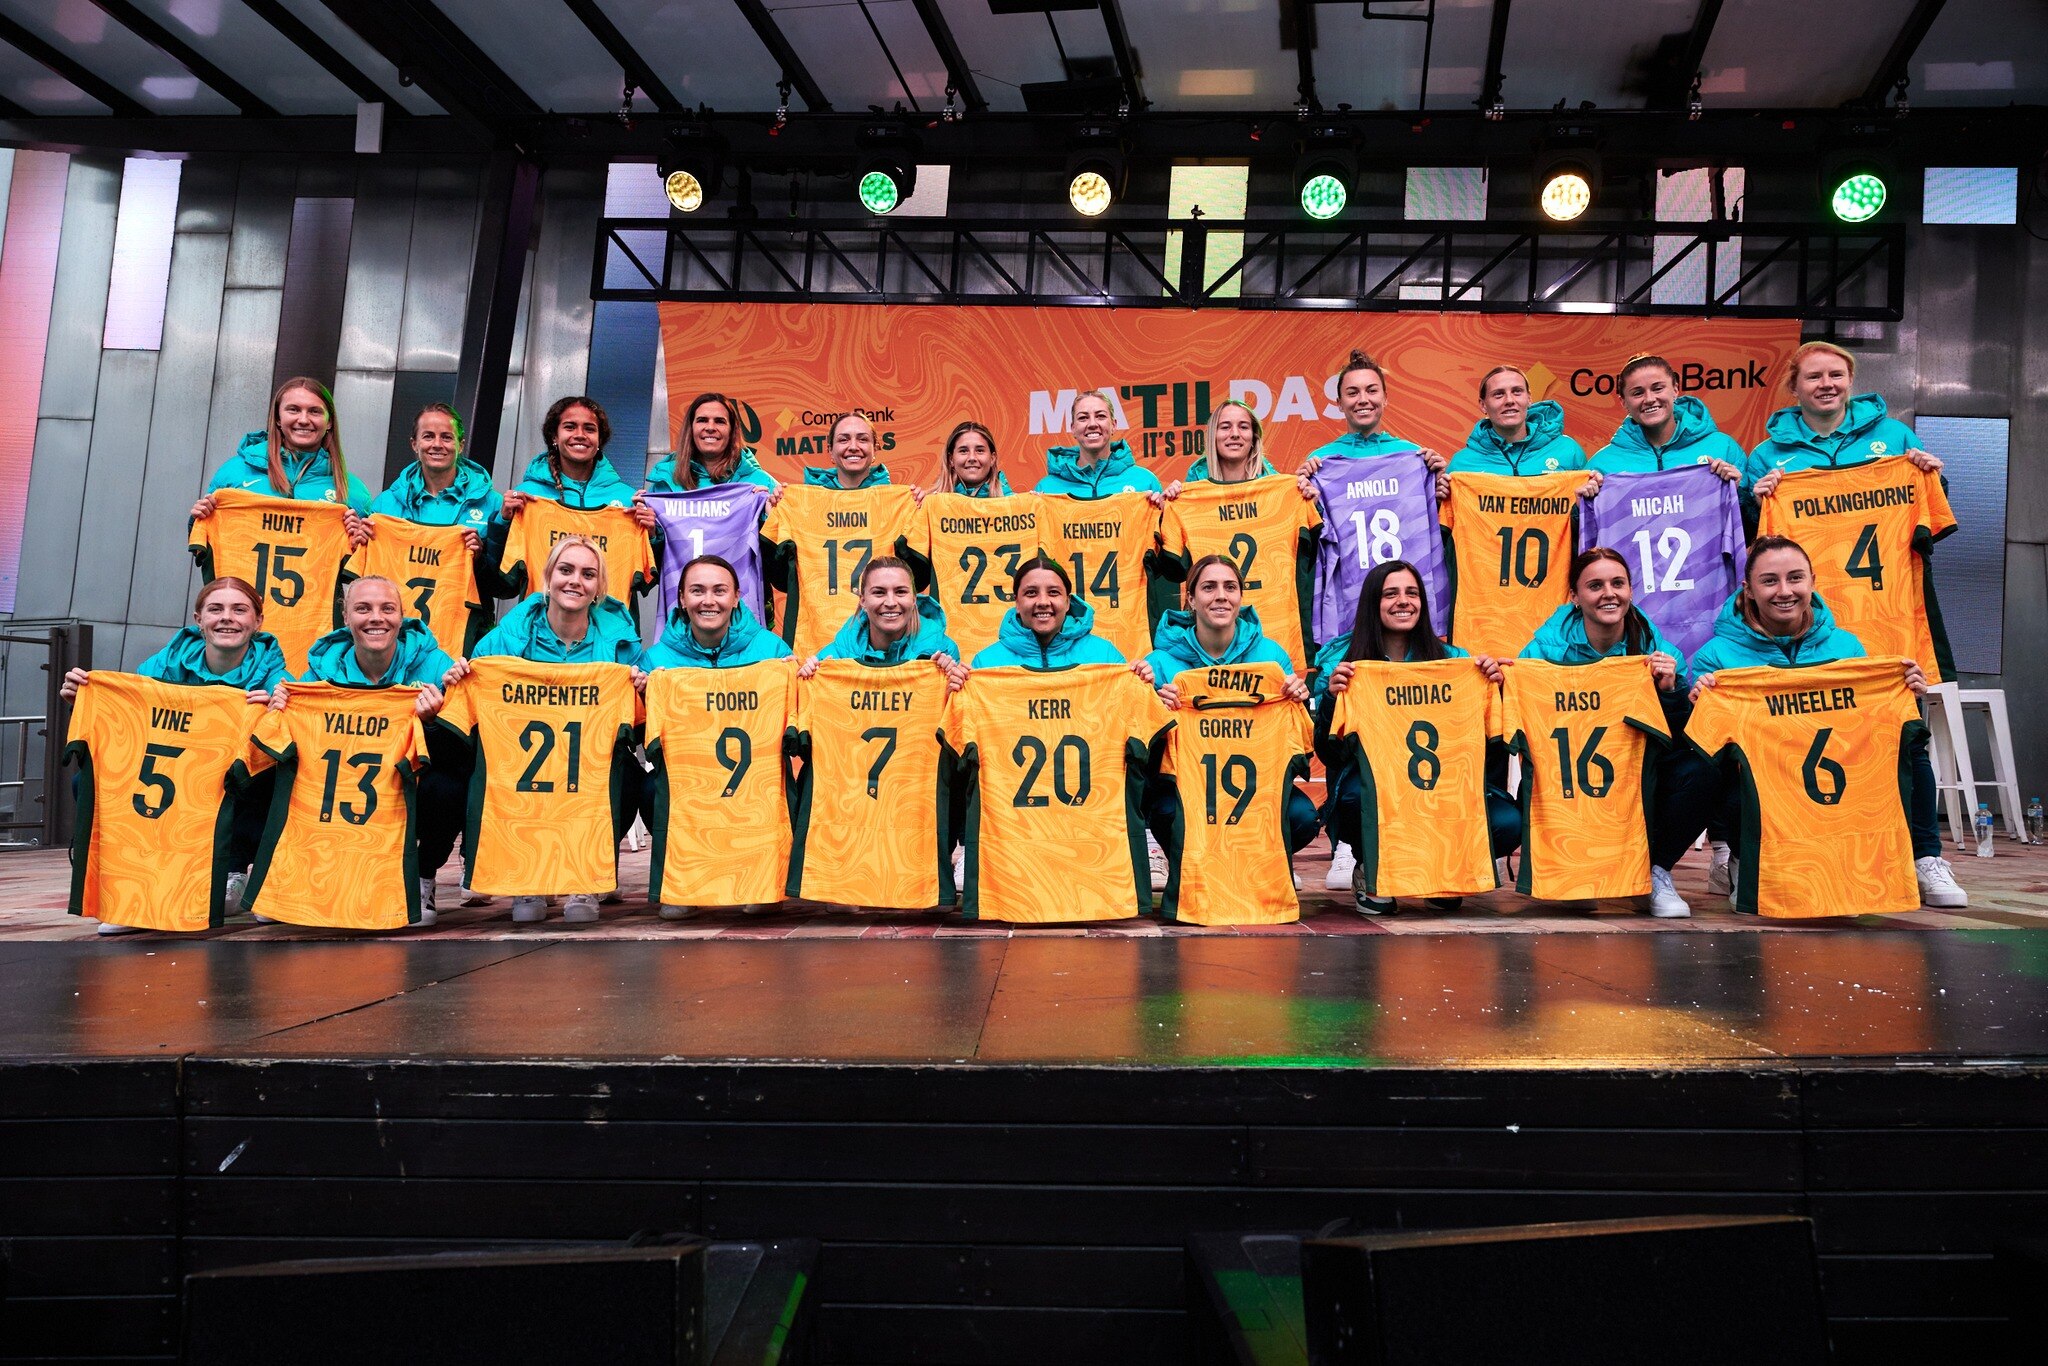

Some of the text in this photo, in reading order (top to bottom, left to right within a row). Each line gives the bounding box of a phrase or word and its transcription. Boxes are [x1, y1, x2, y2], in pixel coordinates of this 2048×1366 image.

[1570, 360, 1769, 397] CoBank
[801, 406, 895, 426] Comank
[1143, 431, 1175, 458] IT'S
[1347, 478, 1399, 499] ARNOLD
[1793, 485, 1915, 518] POLKINGHORNE
[664, 499, 730, 517] WILLIAMS
[1218, 502, 1257, 522] NEVIN
[1478, 495, 1570, 515] VAN EGMOND
[1632, 495, 1684, 517] MICAH
[262, 513, 304, 534] HUNT
[827, 512, 867, 528] SIMON
[941, 513, 1036, 534] COONEY-CROSS
[1063, 522, 1121, 539] KENNEDY
[550, 530, 607, 552] FOER
[1349, 509, 1402, 569] 18
[408, 545, 441, 566] LUIK
[823, 539, 872, 595] 17
[1229, 533, 1261, 590] 2
[1497, 527, 1549, 588] 10
[1632, 527, 1694, 593] 12
[1845, 524, 1883, 590] 4
[252, 542, 307, 607] 15
[959, 544, 1021, 604] 23
[1069, 551, 1120, 608] 14
[502, 683, 600, 706] CARPENTER
[1208, 669, 1264, 694] GRANT
[1386, 683, 1452, 706] CHIDIAC
[706, 690, 758, 712] FOORD
[851, 690, 913, 711] CATLEY
[1028, 699, 1071, 719] KERR
[1555, 691, 1600, 712] RASO
[1765, 687, 1856, 716] WHEELER
[151, 707, 193, 733] VINE
[324, 712, 389, 737] YALLOP
[1200, 718, 1254, 739] GORRY
[516, 720, 582, 793] 21
[716, 727, 752, 797] 9
[860, 727, 897, 800] 7
[1406, 720, 1441, 790] 8
[1550, 727, 1614, 799] 16
[1802, 727, 1846, 805] 6
[132, 742, 186, 819] 5
[1012, 735, 1091, 808] 20
[319, 749, 383, 825] 13
[1200, 754, 1257, 825] 19
